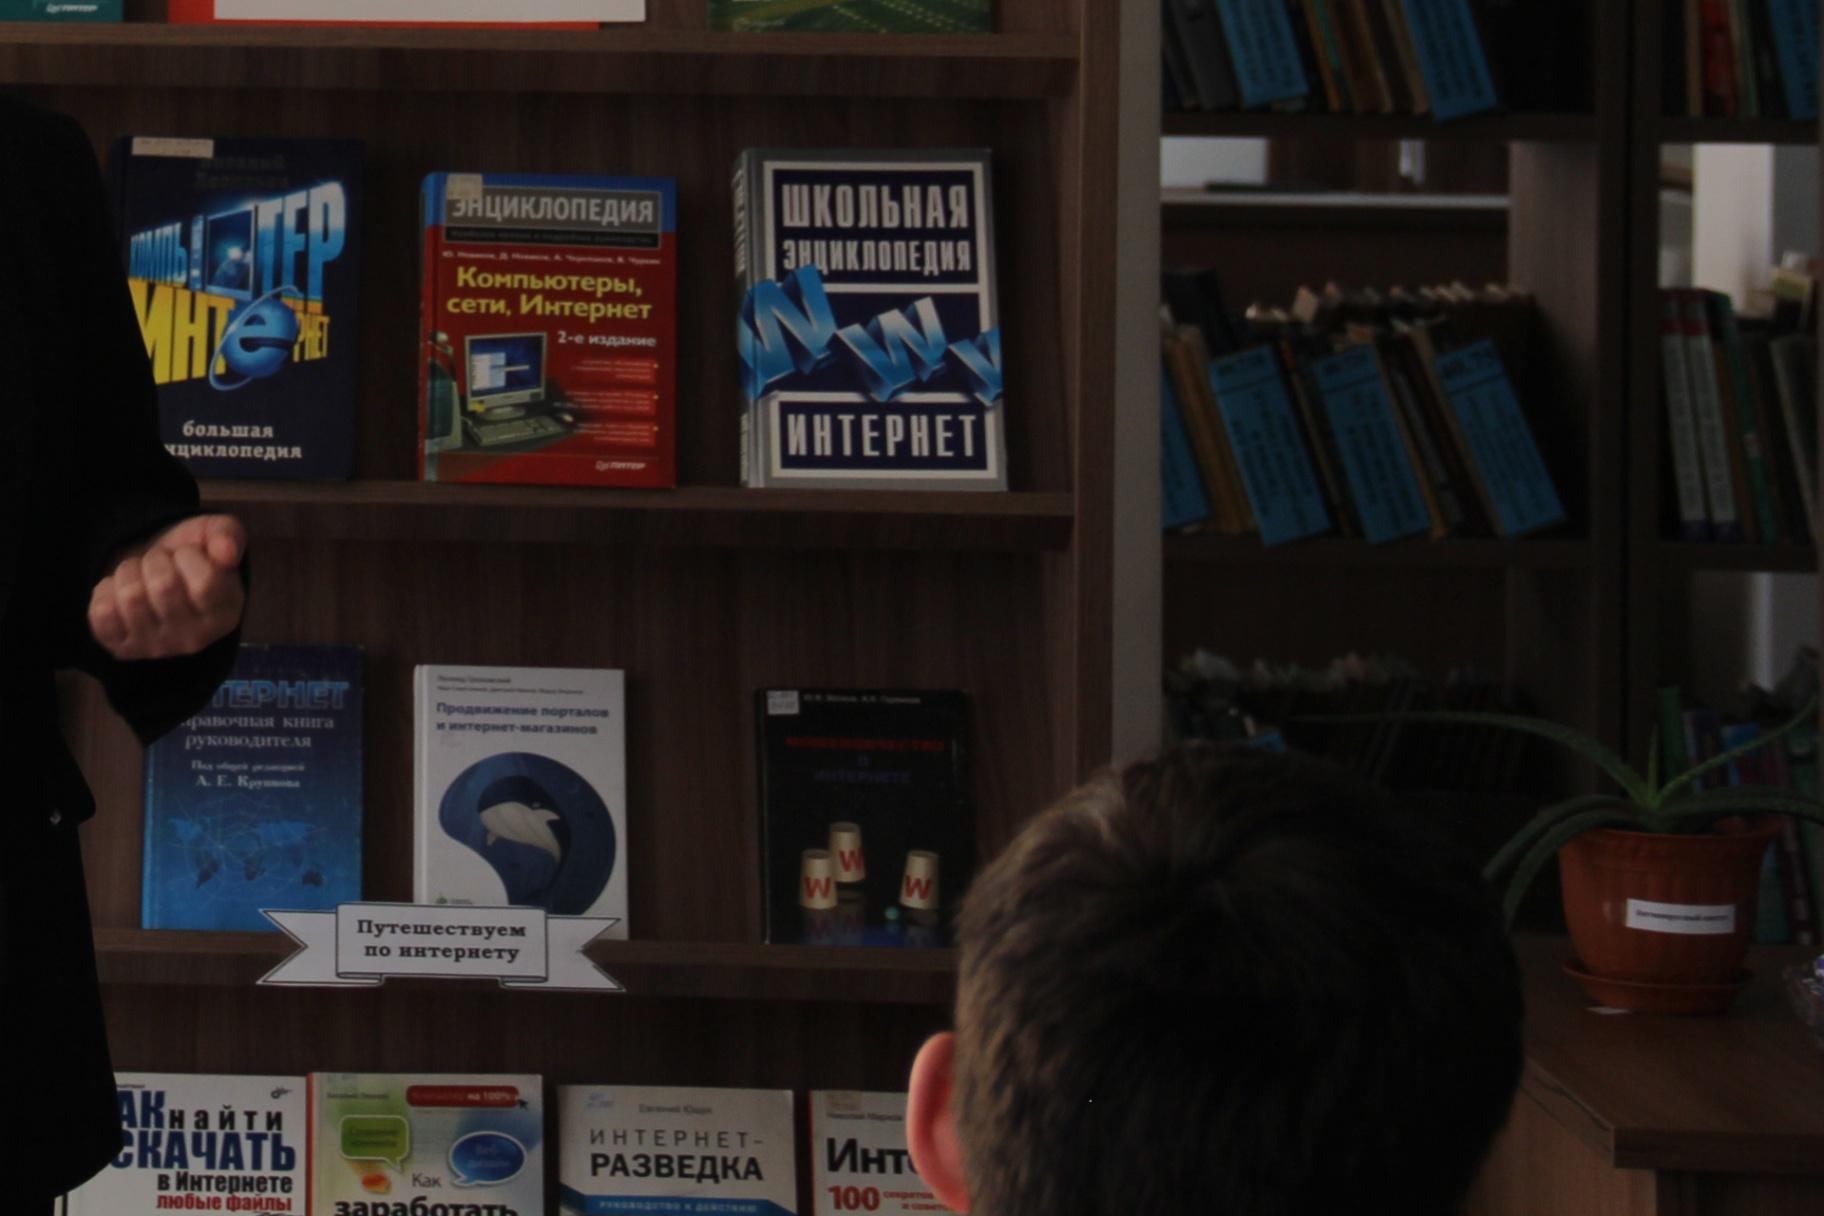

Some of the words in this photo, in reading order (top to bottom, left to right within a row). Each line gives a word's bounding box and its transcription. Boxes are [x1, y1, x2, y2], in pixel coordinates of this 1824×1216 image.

[451, 195, 654, 226] ЭНЦИКЛОПЕДИЯ
[781, 182, 970, 230] ШКОЛЬНАЯ
[782, 239, 972, 277] ЭНЦИКЛОПЕДИЯ
[456, 265, 643, 298] Компьютеры,
[446, 296, 512, 317] сети,
[520, 293, 652, 324] Интернет
[557, 330, 584, 345] 2-е
[588, 335, 657, 348] издание
[182, 419, 274, 439] большая
[786, 413, 977, 458] ИНТЕРНЕТ
[163, 444, 303, 462] нциклопедия
[212, 679, 350, 710] ТЕРНЕТ
[436, 702, 538, 715] Продвижение
[541, 706, 609, 719] порталов
[181, 715, 275, 731] равочная
[283, 716, 335, 729] книга
[436, 722, 446, 730] и
[449, 722, 598, 734] интернет-магазинов
[184, 735, 312, 750] руководителя
[357, 919, 526, 942] Путешествуем
[364, 944, 390, 958] по
[400, 945, 520, 962] интернету
[117, 1091, 165, 1128] АК
[169, 1104, 283, 1131] найти
[112, 1130, 296, 1171] СКАЧАТЬ
[590, 1129, 764, 1148] ИНТЕРНЕТ-
[826, 1137, 918, 1175] Инт
[411, 1173, 441, 1188] Как
[590, 1153, 765, 1184] РАЗВЕДКА
[157, 1173, 170, 1192] в
[175, 1171, 293, 1195] Интернете
[156, 1194, 222, 1211] любые
[226, 1194, 293, 1213] файлы
[826, 1185, 881, 1211] 100
